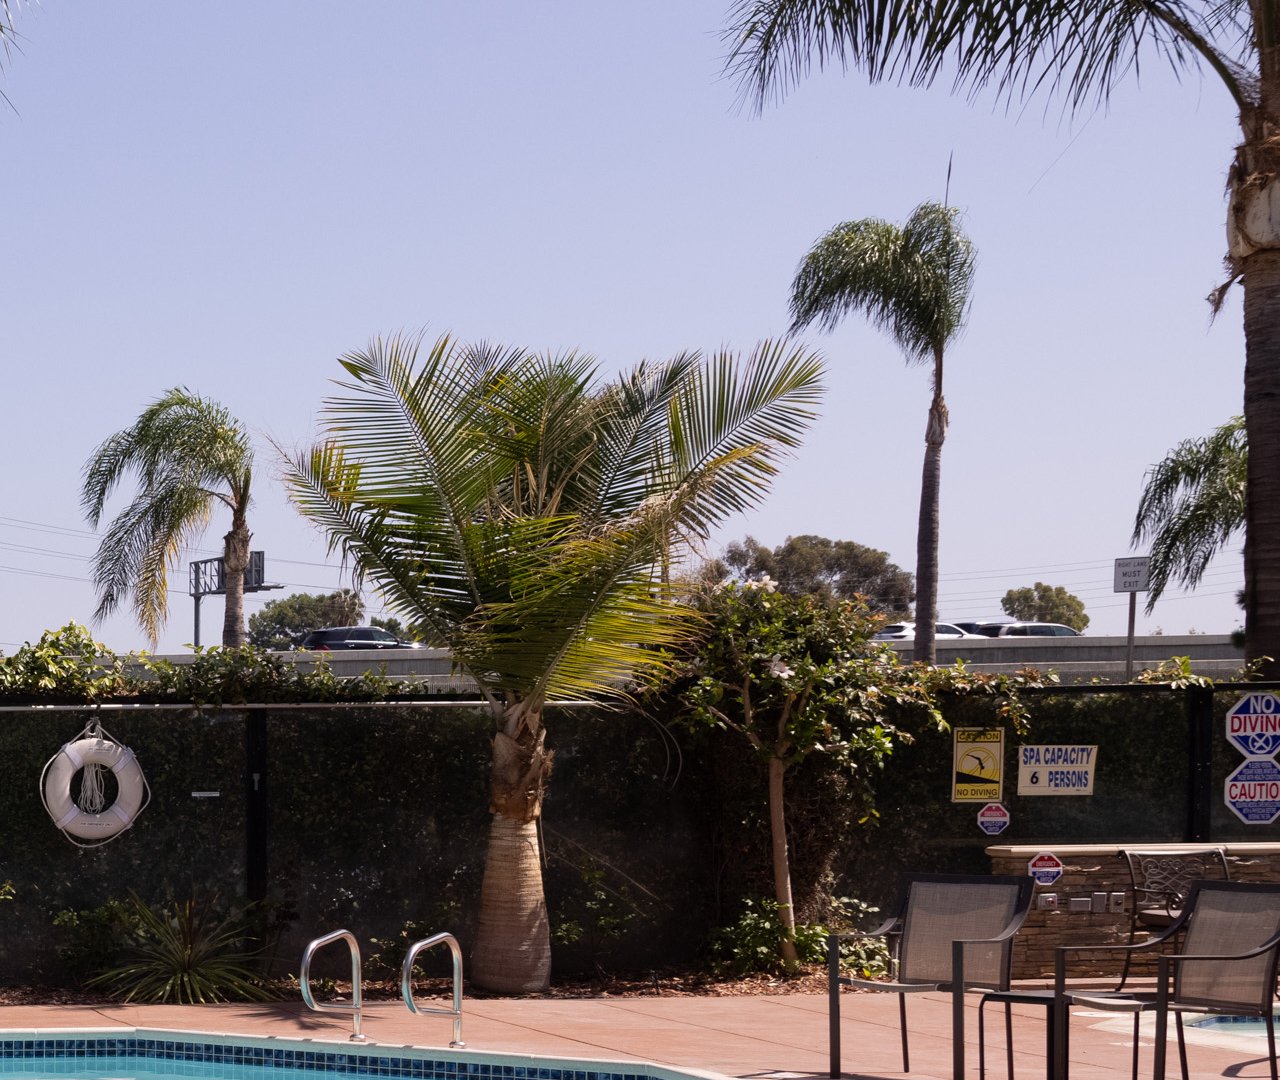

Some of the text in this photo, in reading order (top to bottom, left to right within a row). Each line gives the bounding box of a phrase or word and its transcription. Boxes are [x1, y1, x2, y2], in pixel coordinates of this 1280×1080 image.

[1122, 570, 1141, 578] MUST
[1250, 696, 1275, 714] NO
[1231, 715, 1280, 733] DIVIN
[1022, 747, 1093, 765] SPA CAPACITY
[1030, 771, 1089, 788] 6 PERSONS
[1229, 783, 1280, 800] CAUTIO
